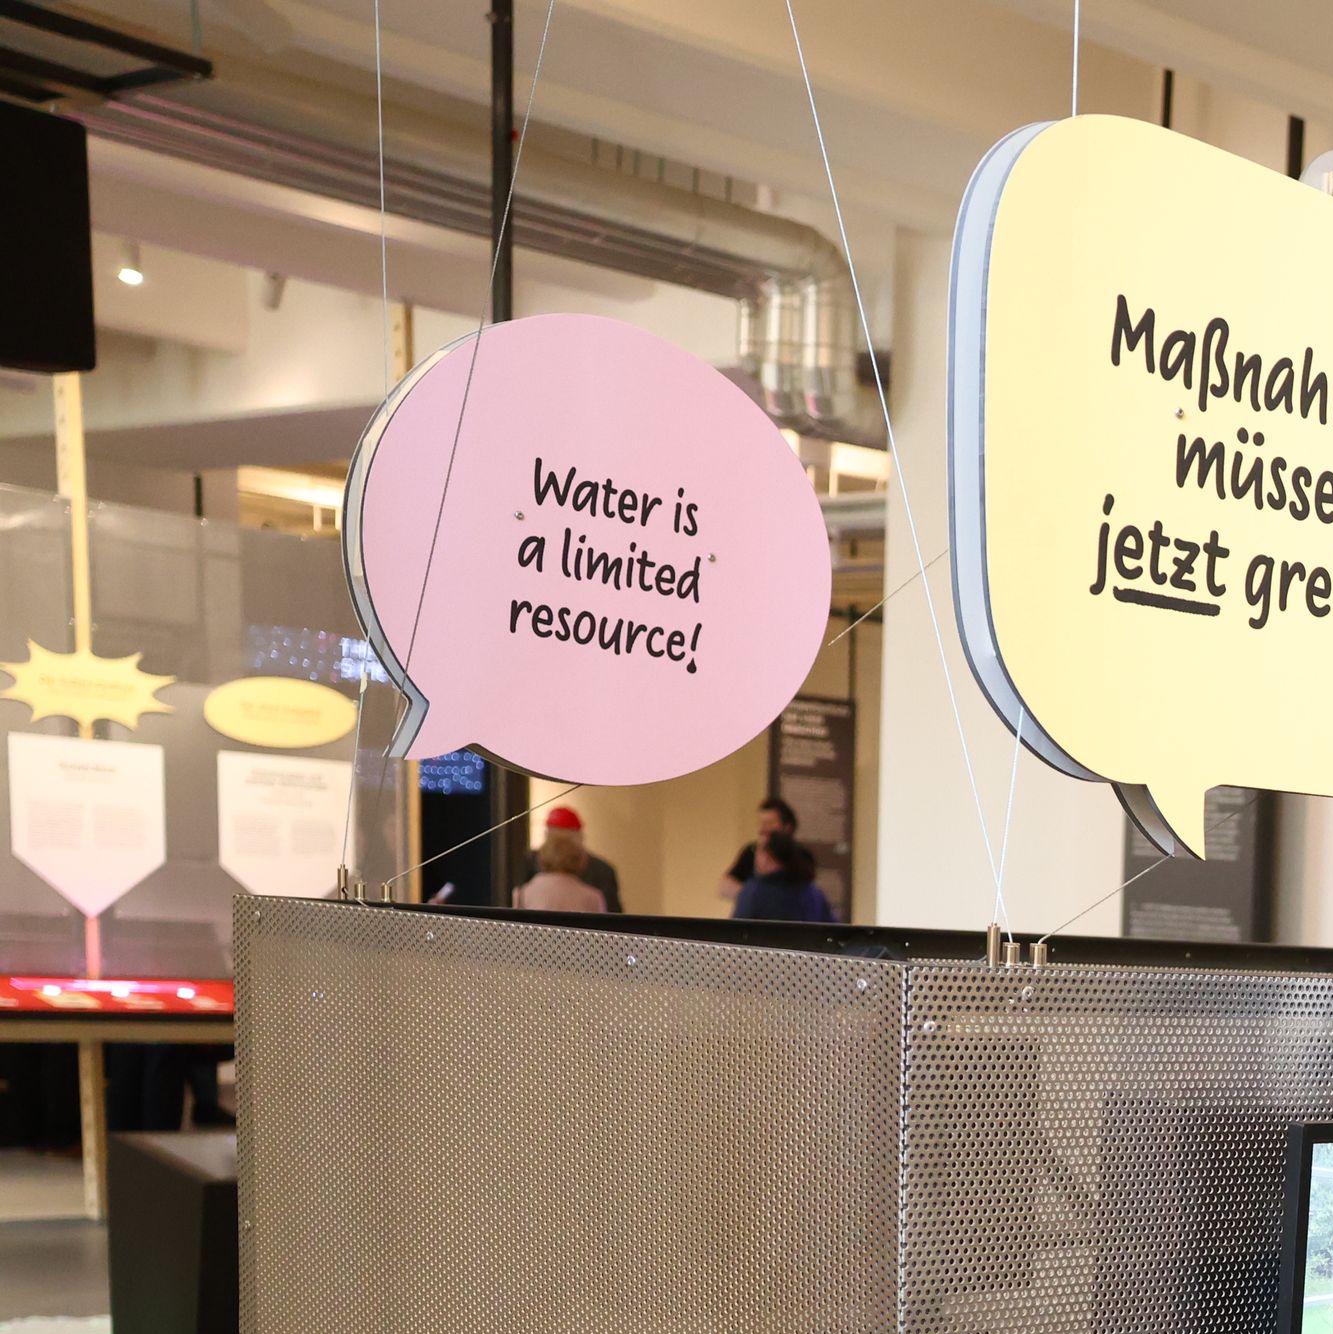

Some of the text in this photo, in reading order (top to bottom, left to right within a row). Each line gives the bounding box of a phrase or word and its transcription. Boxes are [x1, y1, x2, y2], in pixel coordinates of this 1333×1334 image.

[534, 457, 699, 536] Water is
[518, 527, 701, 603] a limited
[1089, 494, 1230, 598] jetzt
[509, 598, 702, 673] resource!
